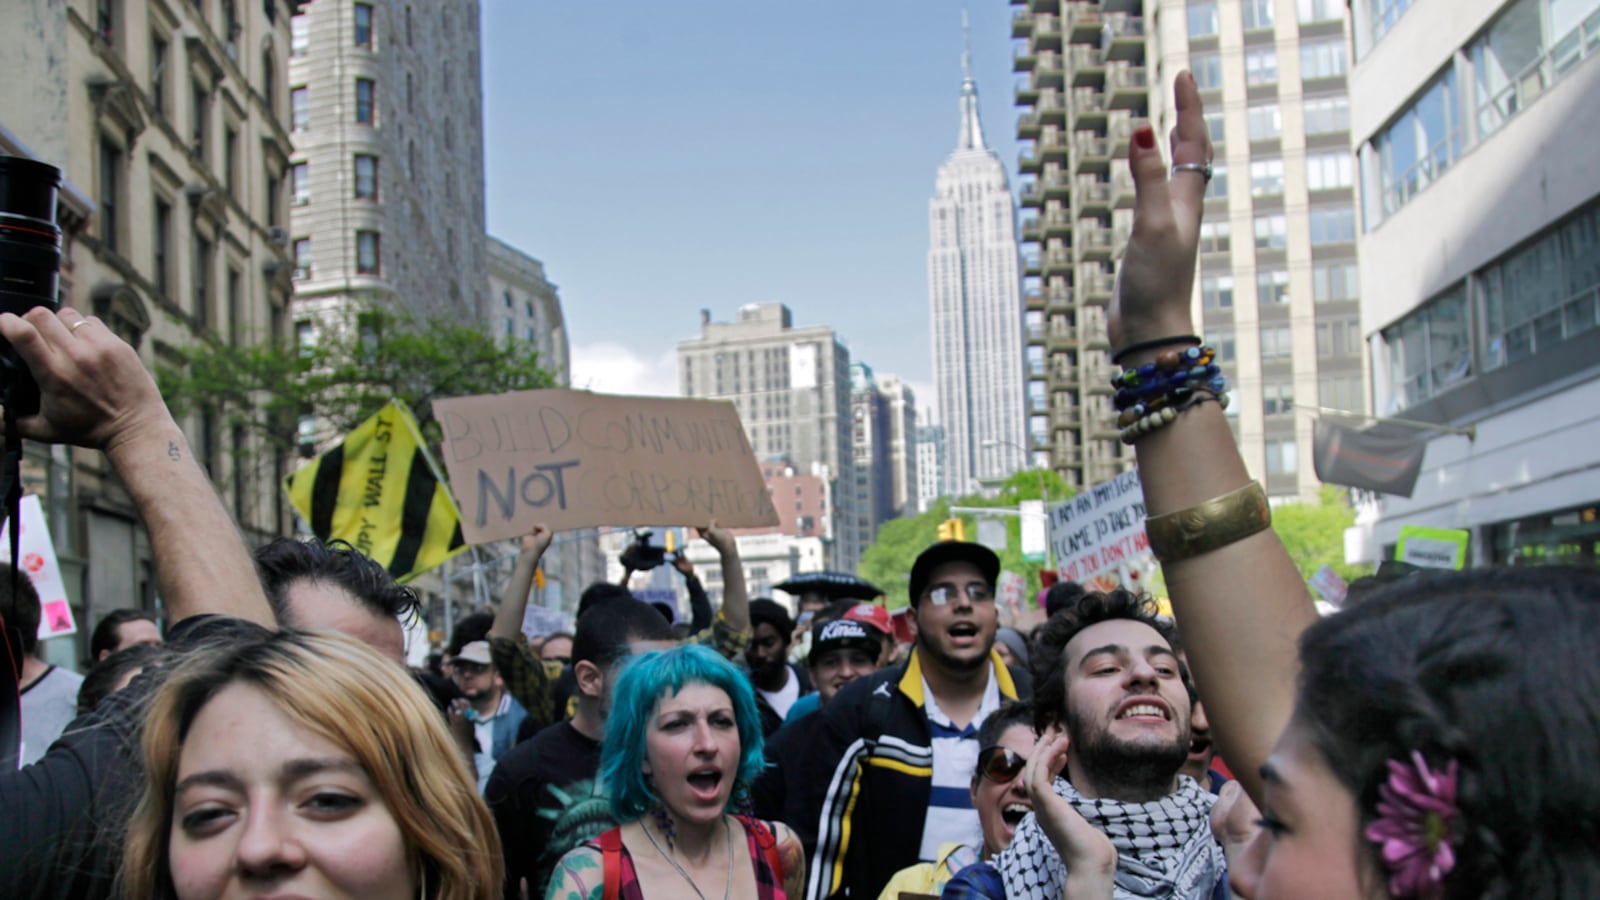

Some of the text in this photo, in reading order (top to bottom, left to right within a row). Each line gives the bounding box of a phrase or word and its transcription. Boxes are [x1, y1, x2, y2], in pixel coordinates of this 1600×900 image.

[443, 406, 572, 464] BUILD
[357, 415, 393, 557] UPY WALL ST
[475, 458, 581, 528] NOT
[1048, 473, 1139, 531] I AM AN IMMIGR
[1053, 502, 1147, 561] I CAME TO TAKE YO
[1080, 552, 1099, 576] YOU
[1100, 535, 1133, 566] DON'T
[1133, 530, 1150, 553] HA
